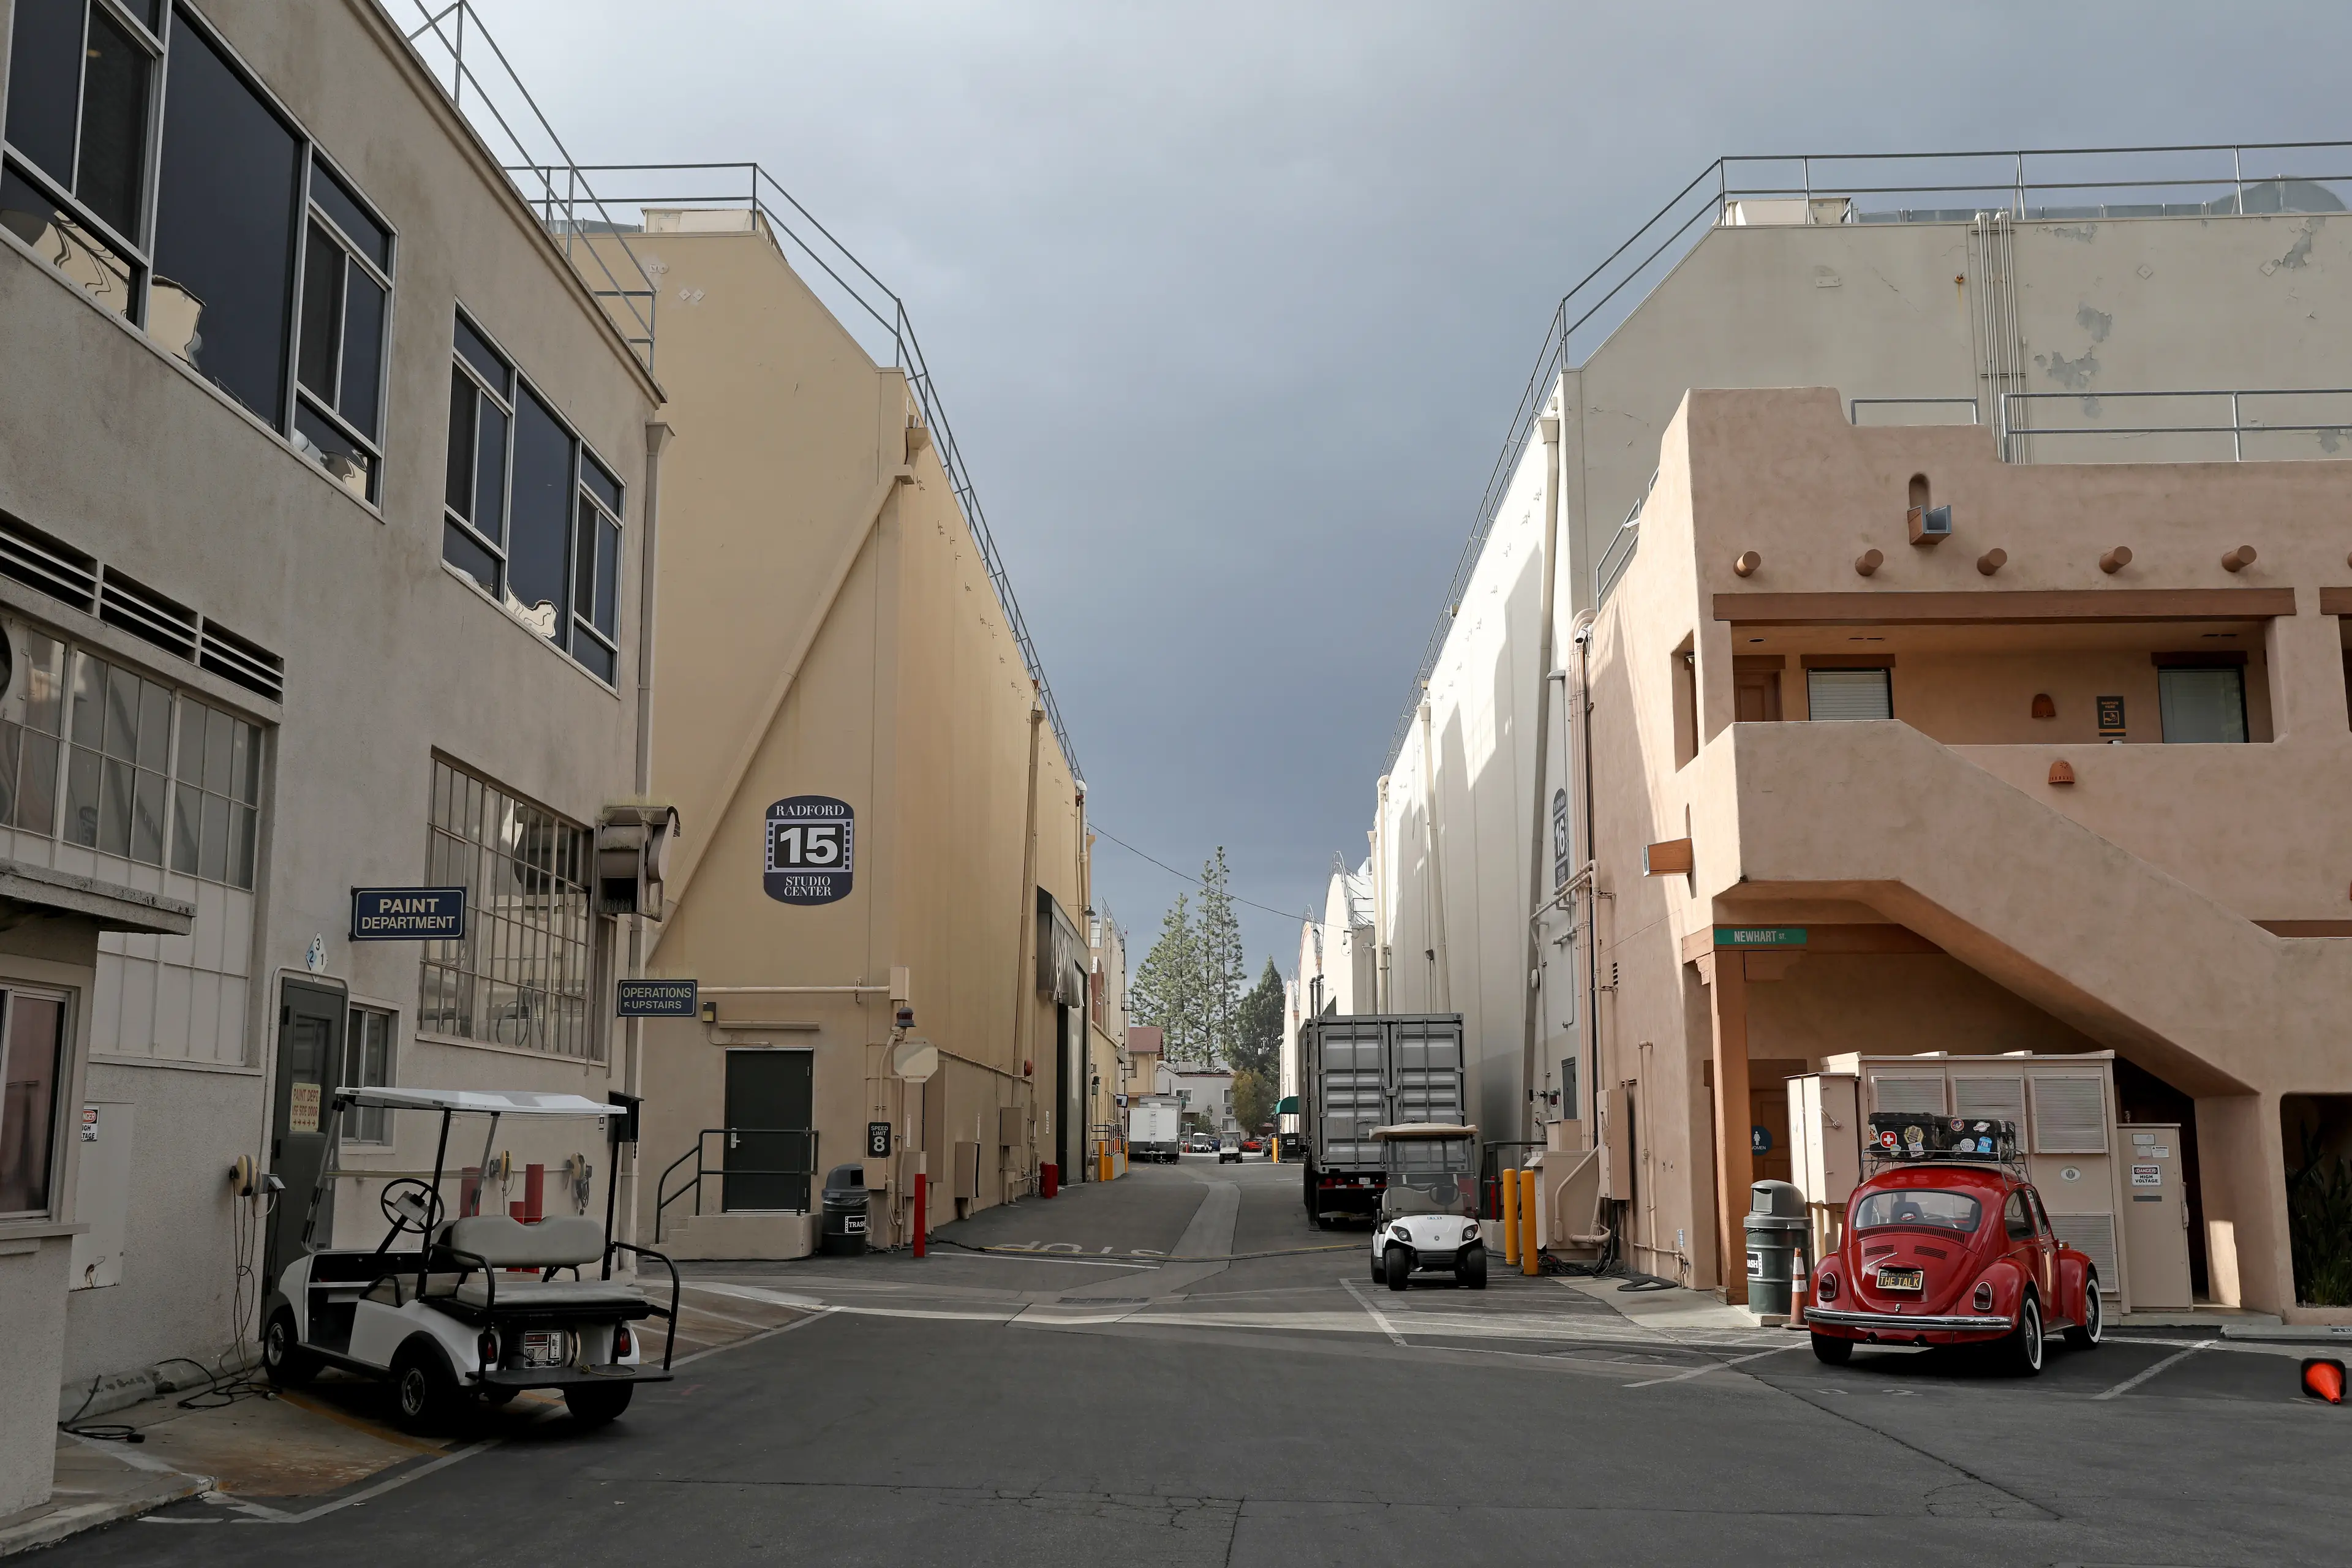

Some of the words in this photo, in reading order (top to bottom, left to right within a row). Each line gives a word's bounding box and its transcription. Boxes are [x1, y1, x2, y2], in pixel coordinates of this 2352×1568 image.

[775, 805, 845, 816] RADFORD
[1556, 818, 1565, 856] 16
[780, 827, 839, 864] 15
[786, 876, 831, 886] STUDIO
[784, 886, 832, 897] CENTER
[379, 899, 439, 913] PAINT
[361, 916, 455, 929] DEPARTMENT
[1734, 930, 1776, 942] NEWHART
[315, 938, 320, 951] 3
[309, 950, 314, 963] 2
[320, 953, 324, 965] 1
[623, 987, 692, 998] OPERATIONS
[293, 1088, 306, 1101] PAINT
[308, 1106, 318, 1117] DOOR
[873, 1136, 885, 1152] 8
[1880, 1276, 1896, 1286] THE
[1898, 1277, 1919, 1287] TALK
